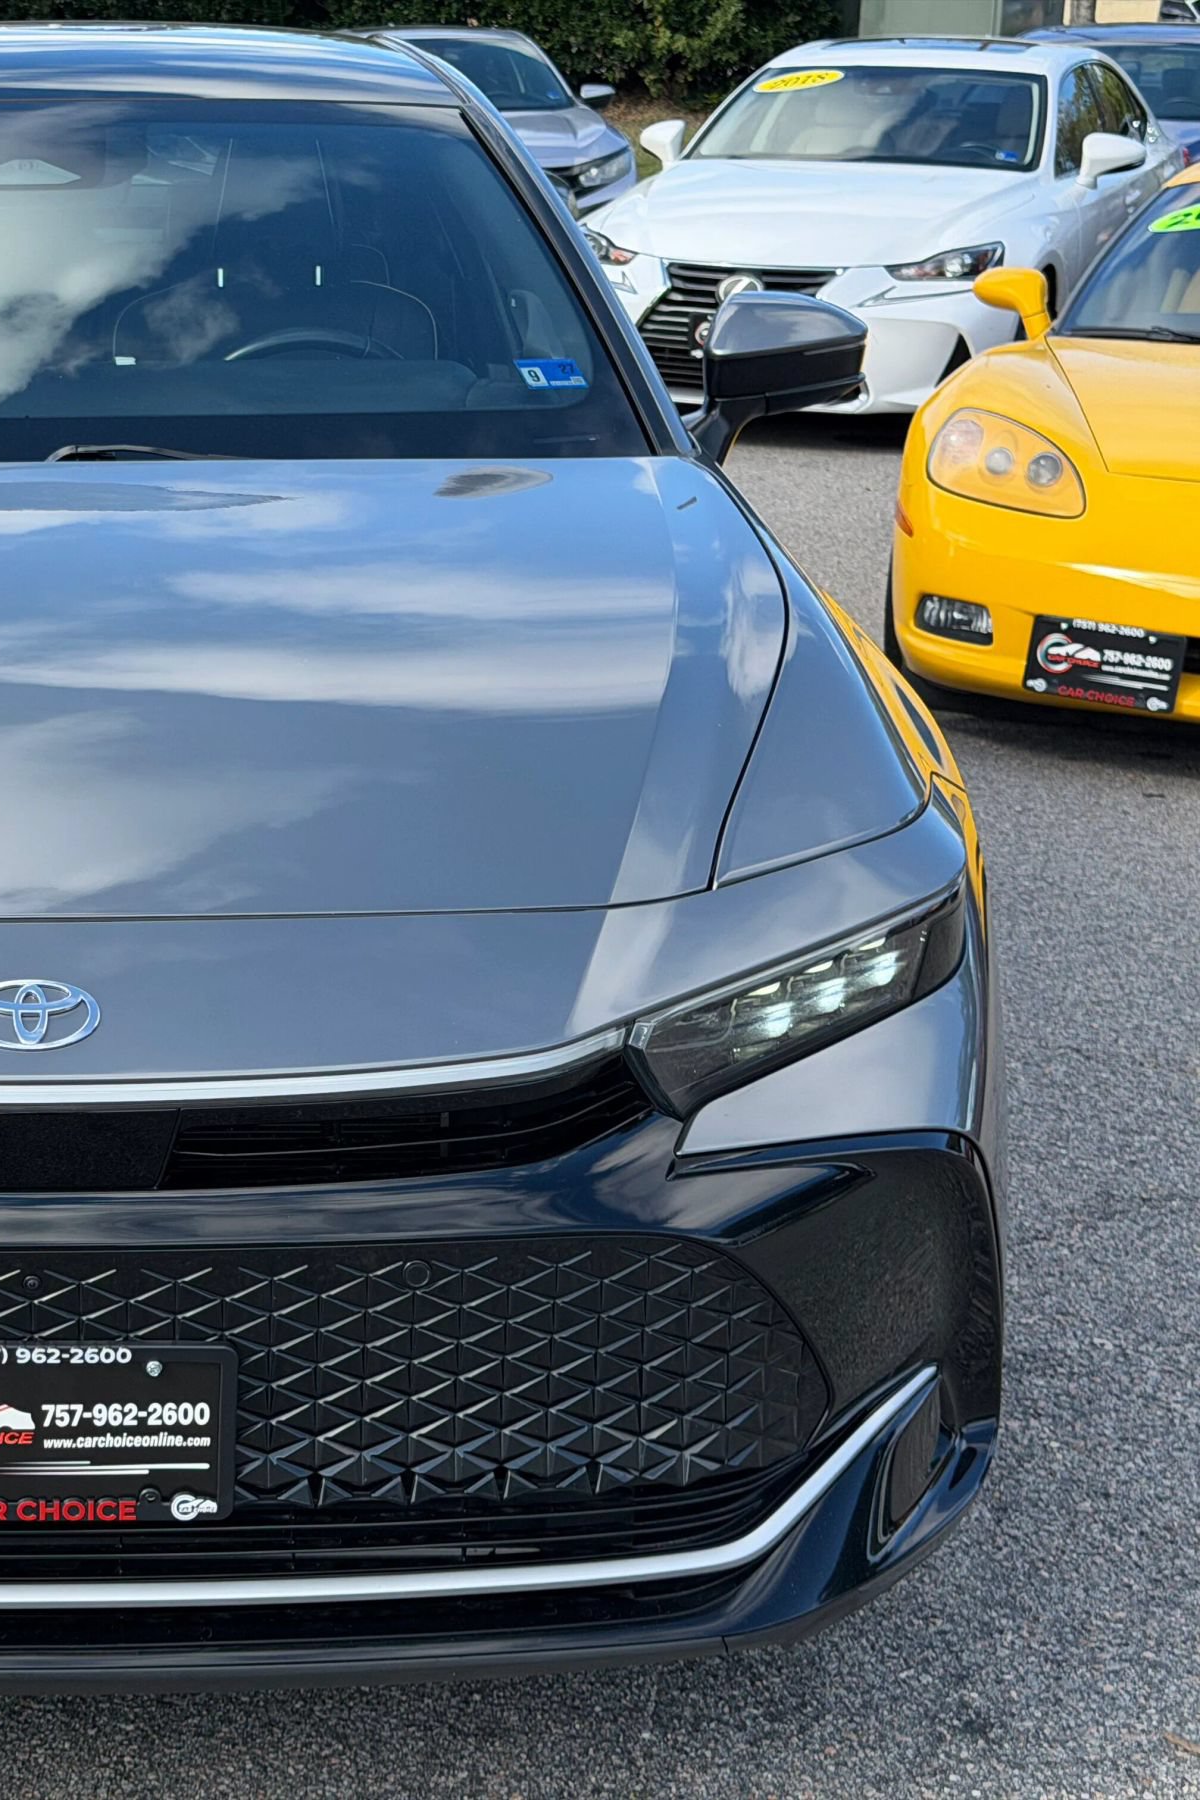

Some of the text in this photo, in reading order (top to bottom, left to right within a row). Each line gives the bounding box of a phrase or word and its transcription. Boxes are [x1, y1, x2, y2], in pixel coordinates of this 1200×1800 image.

[527, 369, 541, 382] 9
[1098, 624, 1146, 638] 962-2600
[1103, 649, 1172, 671] 757-962-2600
[1058, 684, 1136, 707] CAR CHOICE
[16, 1346, 132, 1364] 962-2600
[41, 1402, 211, 1428] 757-962-2600
[43, 1431, 211, 1449] www.carchoiceonline.com
[16, 1499, 138, 1521] CHOICE
